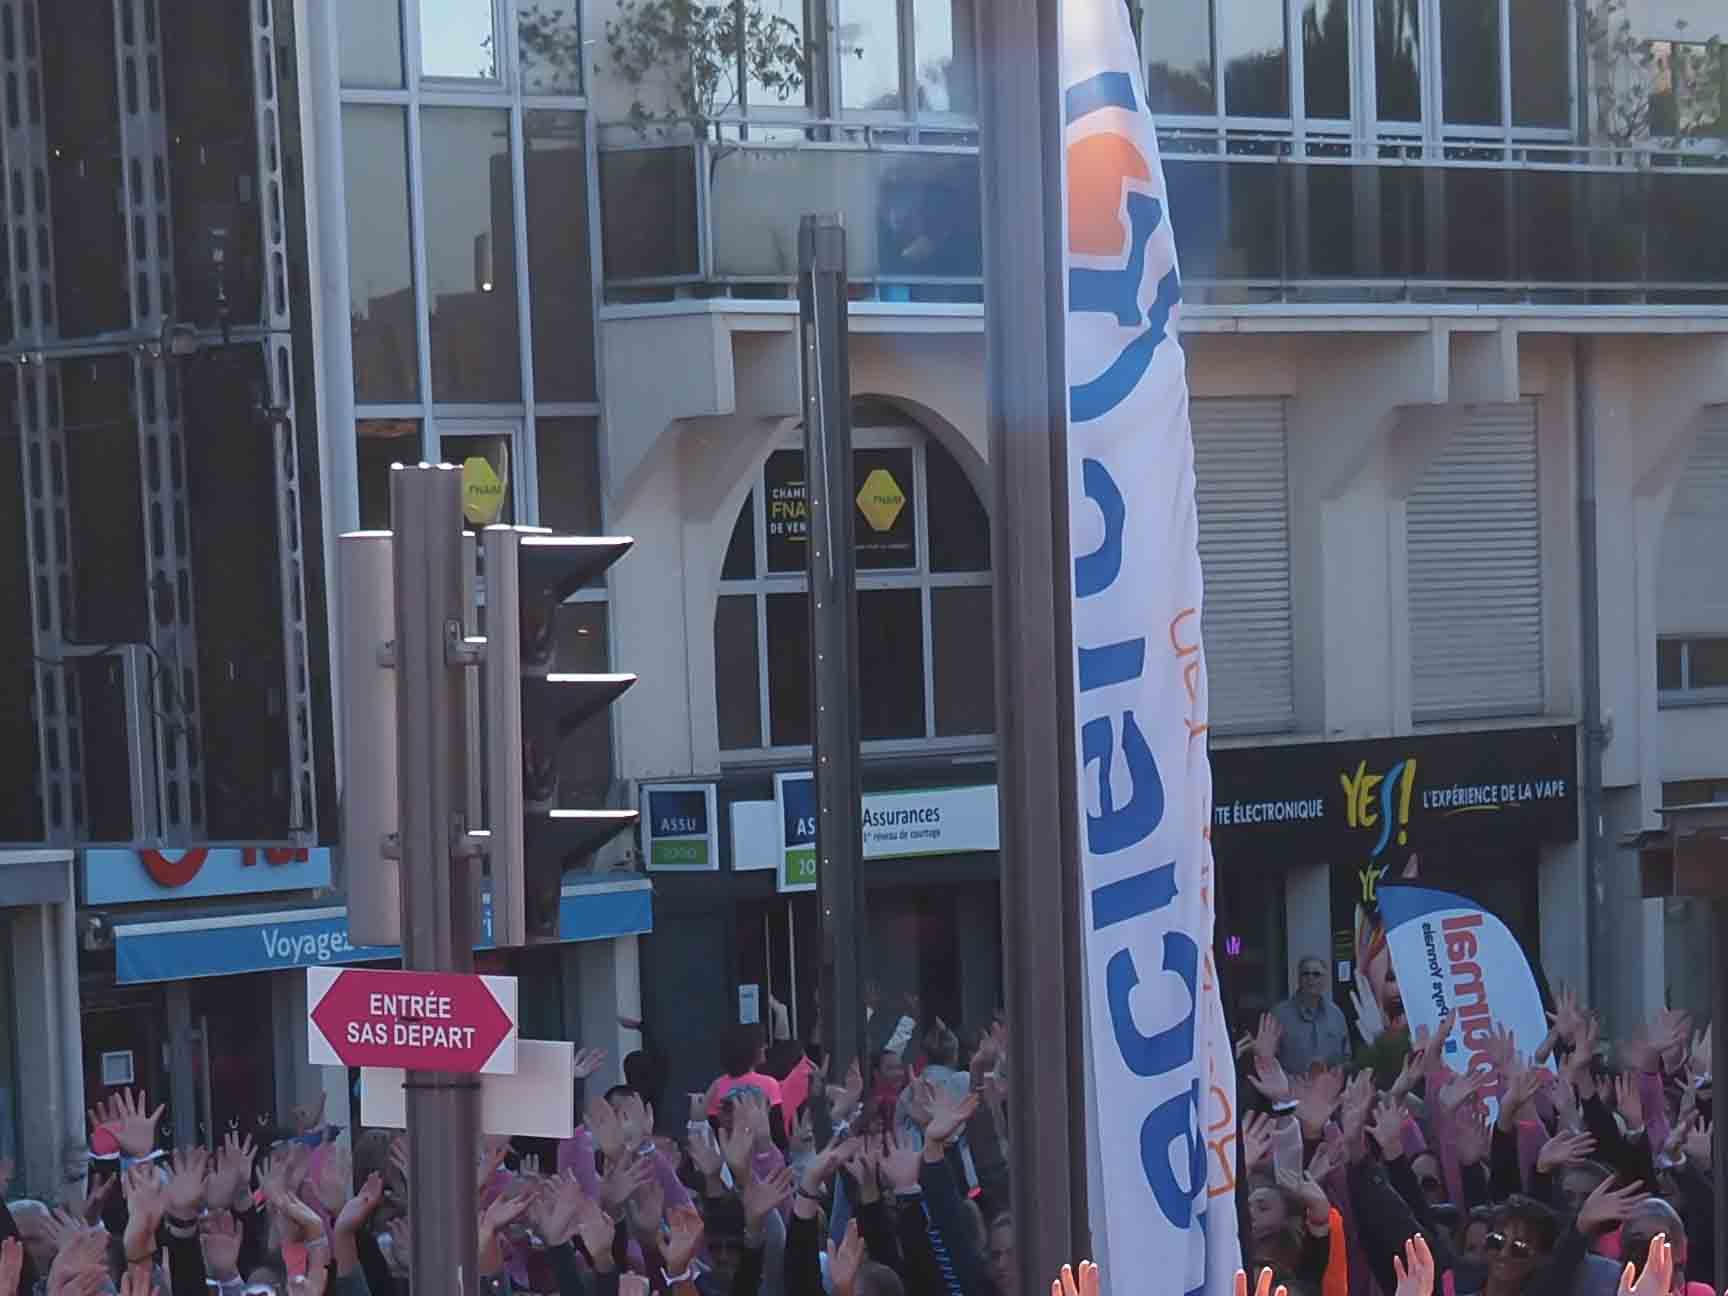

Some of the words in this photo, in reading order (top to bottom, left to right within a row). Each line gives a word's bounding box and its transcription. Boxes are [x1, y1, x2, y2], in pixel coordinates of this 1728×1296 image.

[773, 502, 807, 518] FNA
[787, 523, 807, 534] VEN
[1423, 783, 1499, 809] L'EXPÉRIENCE
[1501, 783, 1518, 802] DE
[1518, 783, 1532, 800] LA
[1535, 780, 1566, 799] VAPE
[863, 806, 941, 828] Assurances
[1233, 798, 1323, 824] ÉLECTRONIQUE
[660, 817, 697, 832] ASSU
[796, 820, 815, 836] AS
[370, 990, 452, 1018] ENTRÉE
[347, 1021, 389, 1046] SAS
